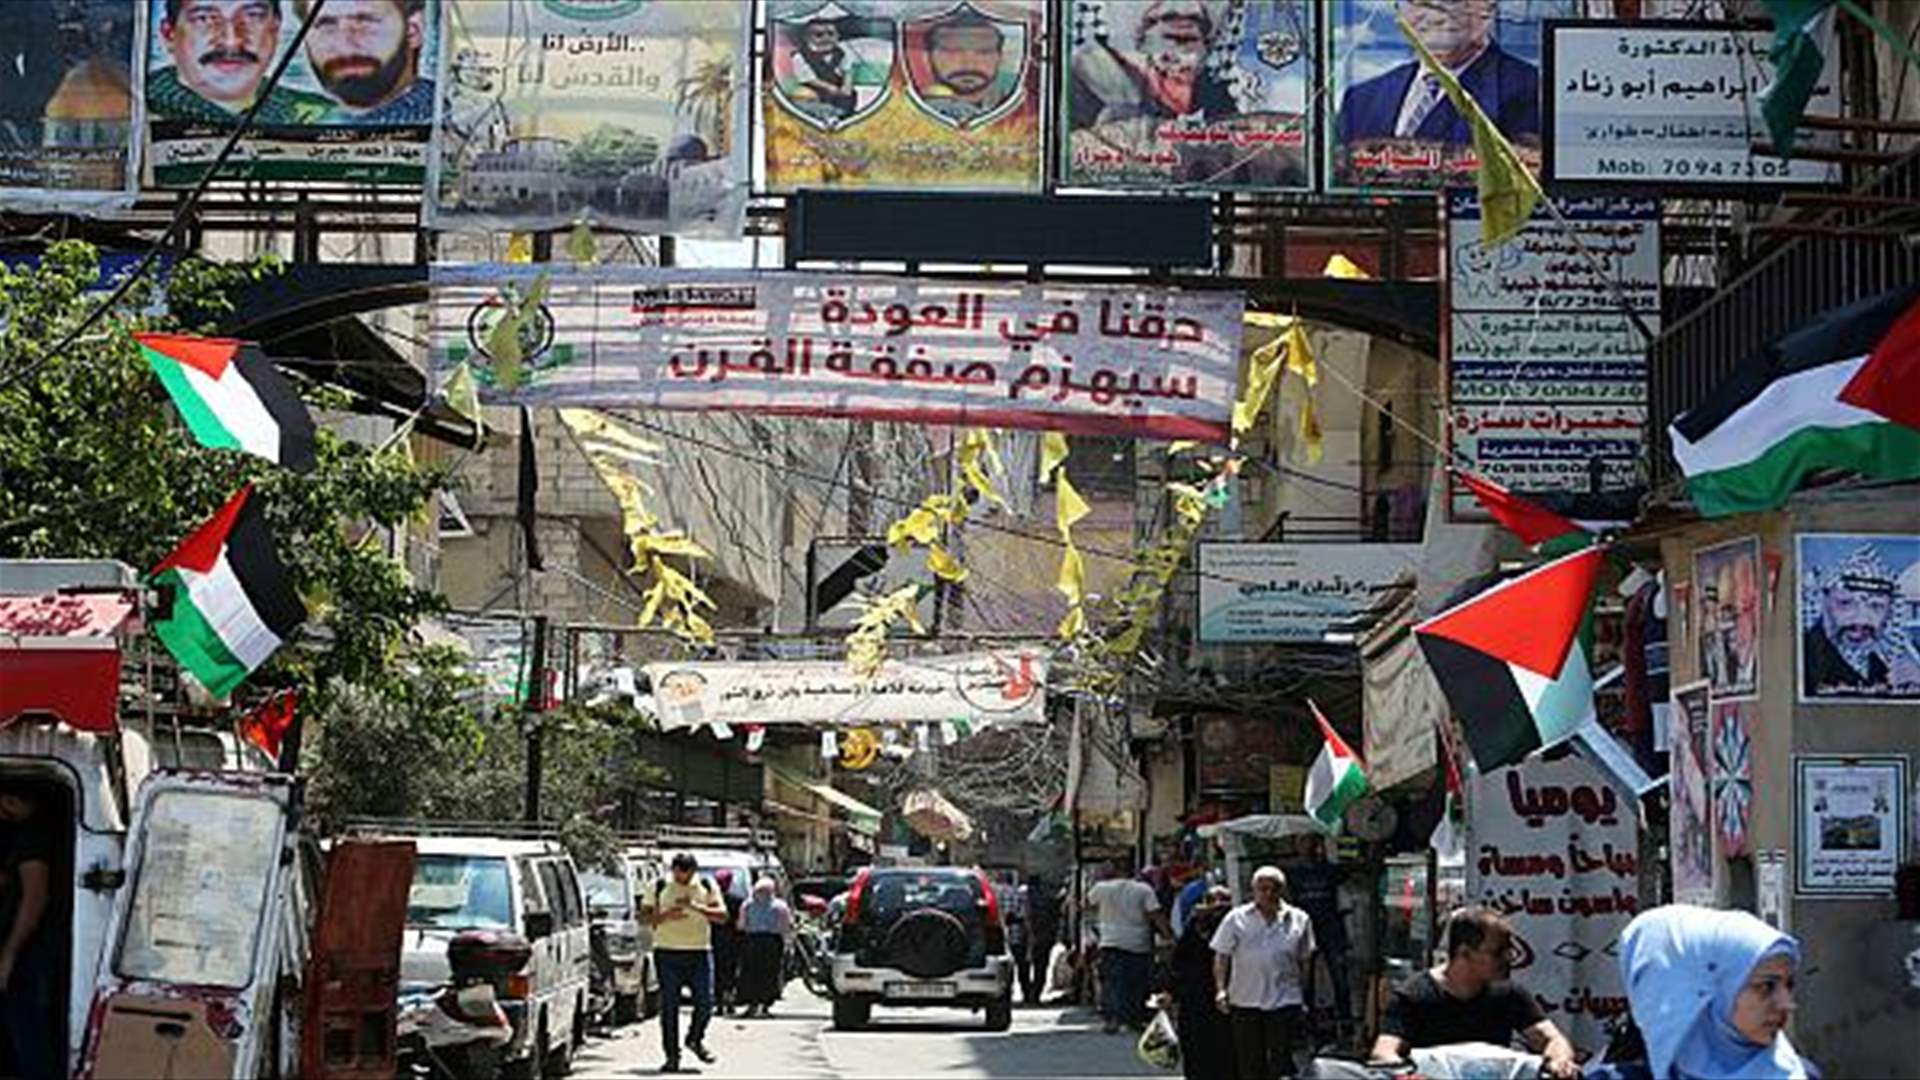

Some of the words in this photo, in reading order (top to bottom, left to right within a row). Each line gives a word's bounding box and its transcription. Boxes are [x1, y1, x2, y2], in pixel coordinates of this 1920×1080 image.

[542, 32, 566, 52] لنا
[1617, 35, 1716, 58] الدكتورة
[1722, 36, 1770, 57] يادة
[516, 62, 546, 85] لنا
[551, 61, 661, 92] والقدس
[1565, 69, 1614, 98] زناد
[1622, 69, 1655, 100] أبو
[818, 289, 986, 337] العودة
[998, 300, 1081, 351] في
[1098, 299, 1206, 343] حقنا
[669, 337, 814, 384] القرن
[823, 341, 998, 385] صفقة
[1008, 354, 1199, 409] سيهزم
[1530, 409, 1646, 435] ختبرات
[1506, 769, 1619, 828] يوميا
